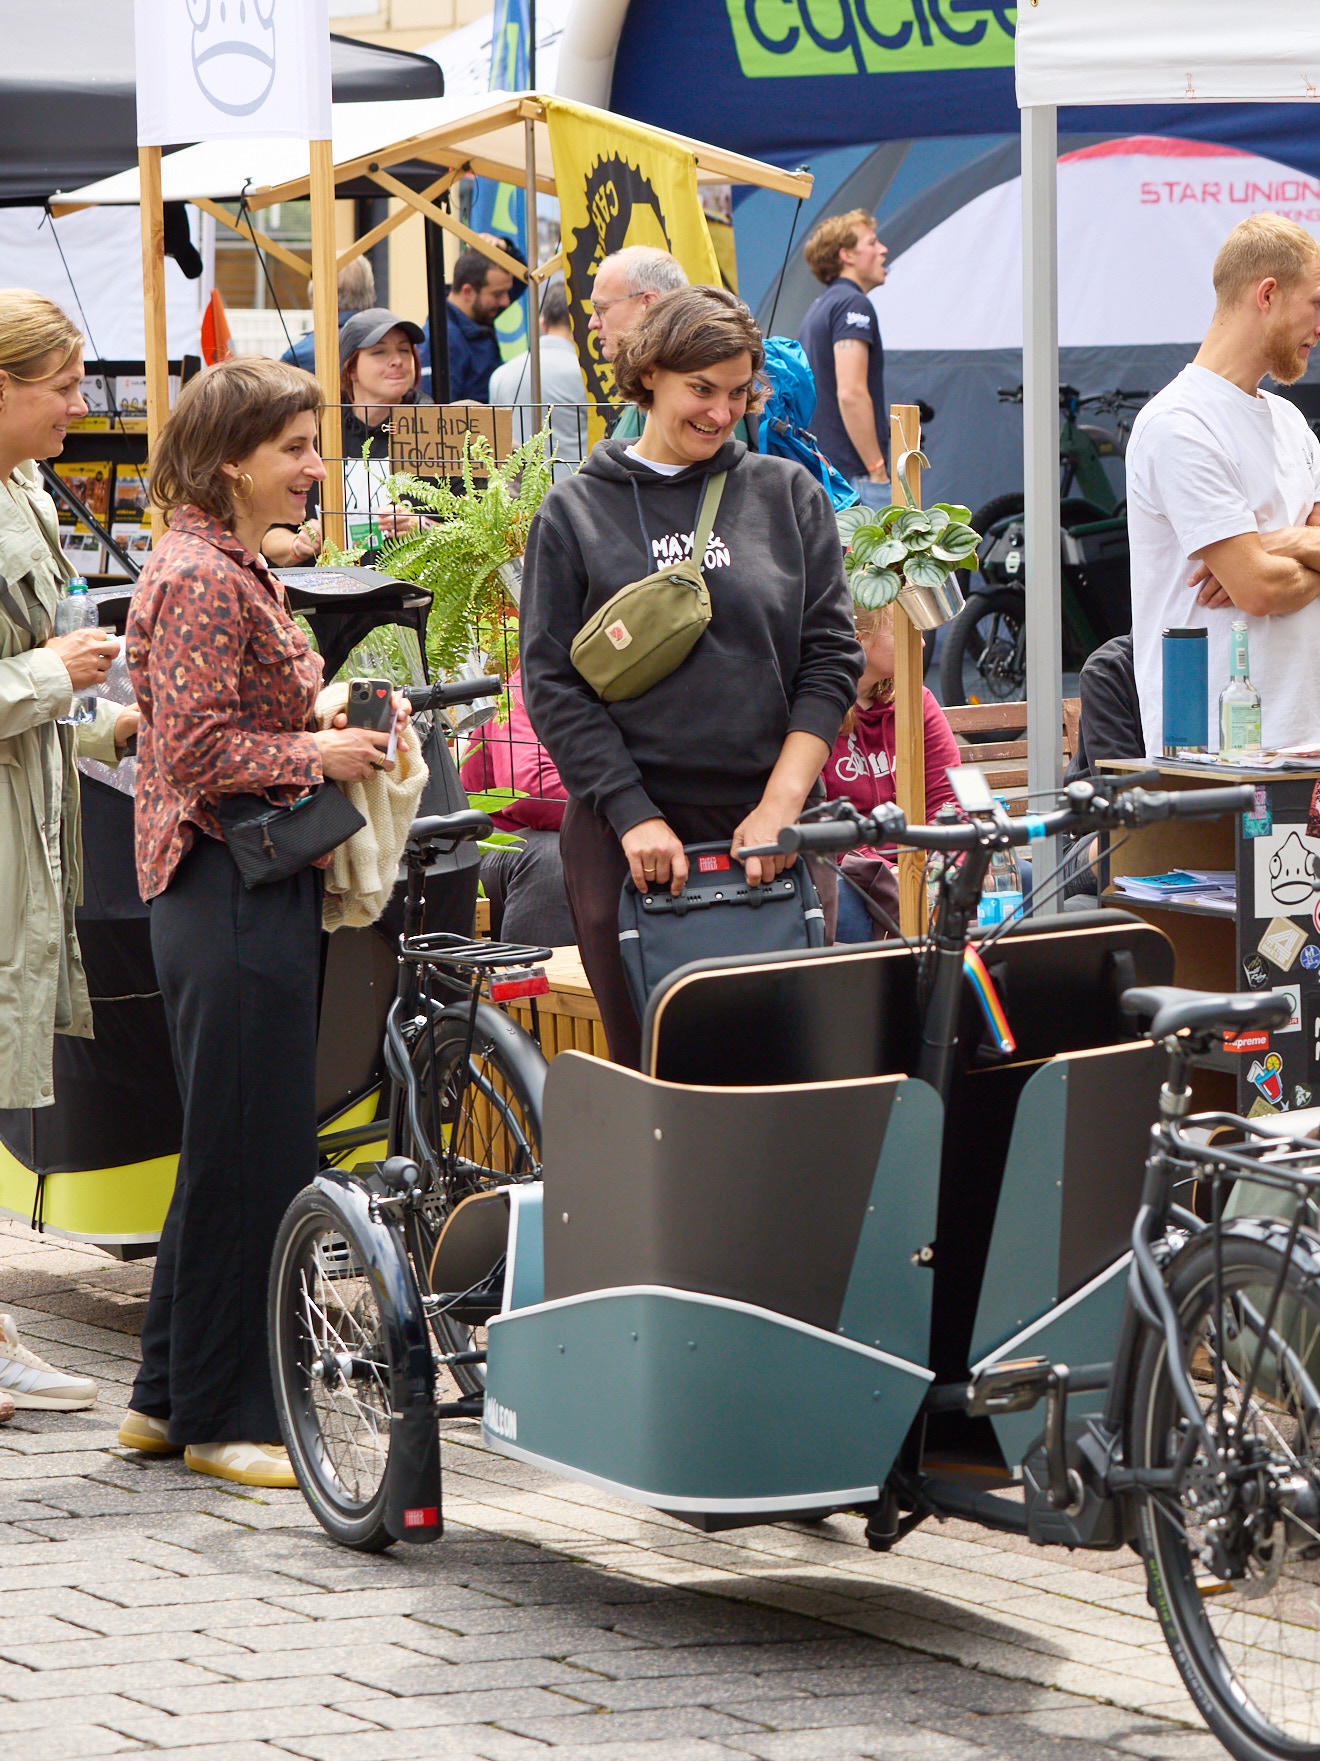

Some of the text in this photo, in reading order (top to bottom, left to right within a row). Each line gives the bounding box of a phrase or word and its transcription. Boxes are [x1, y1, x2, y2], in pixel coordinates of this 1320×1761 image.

[1140, 181, 1221, 203] STAR
[398, 416, 481, 436] ALL RIDE
